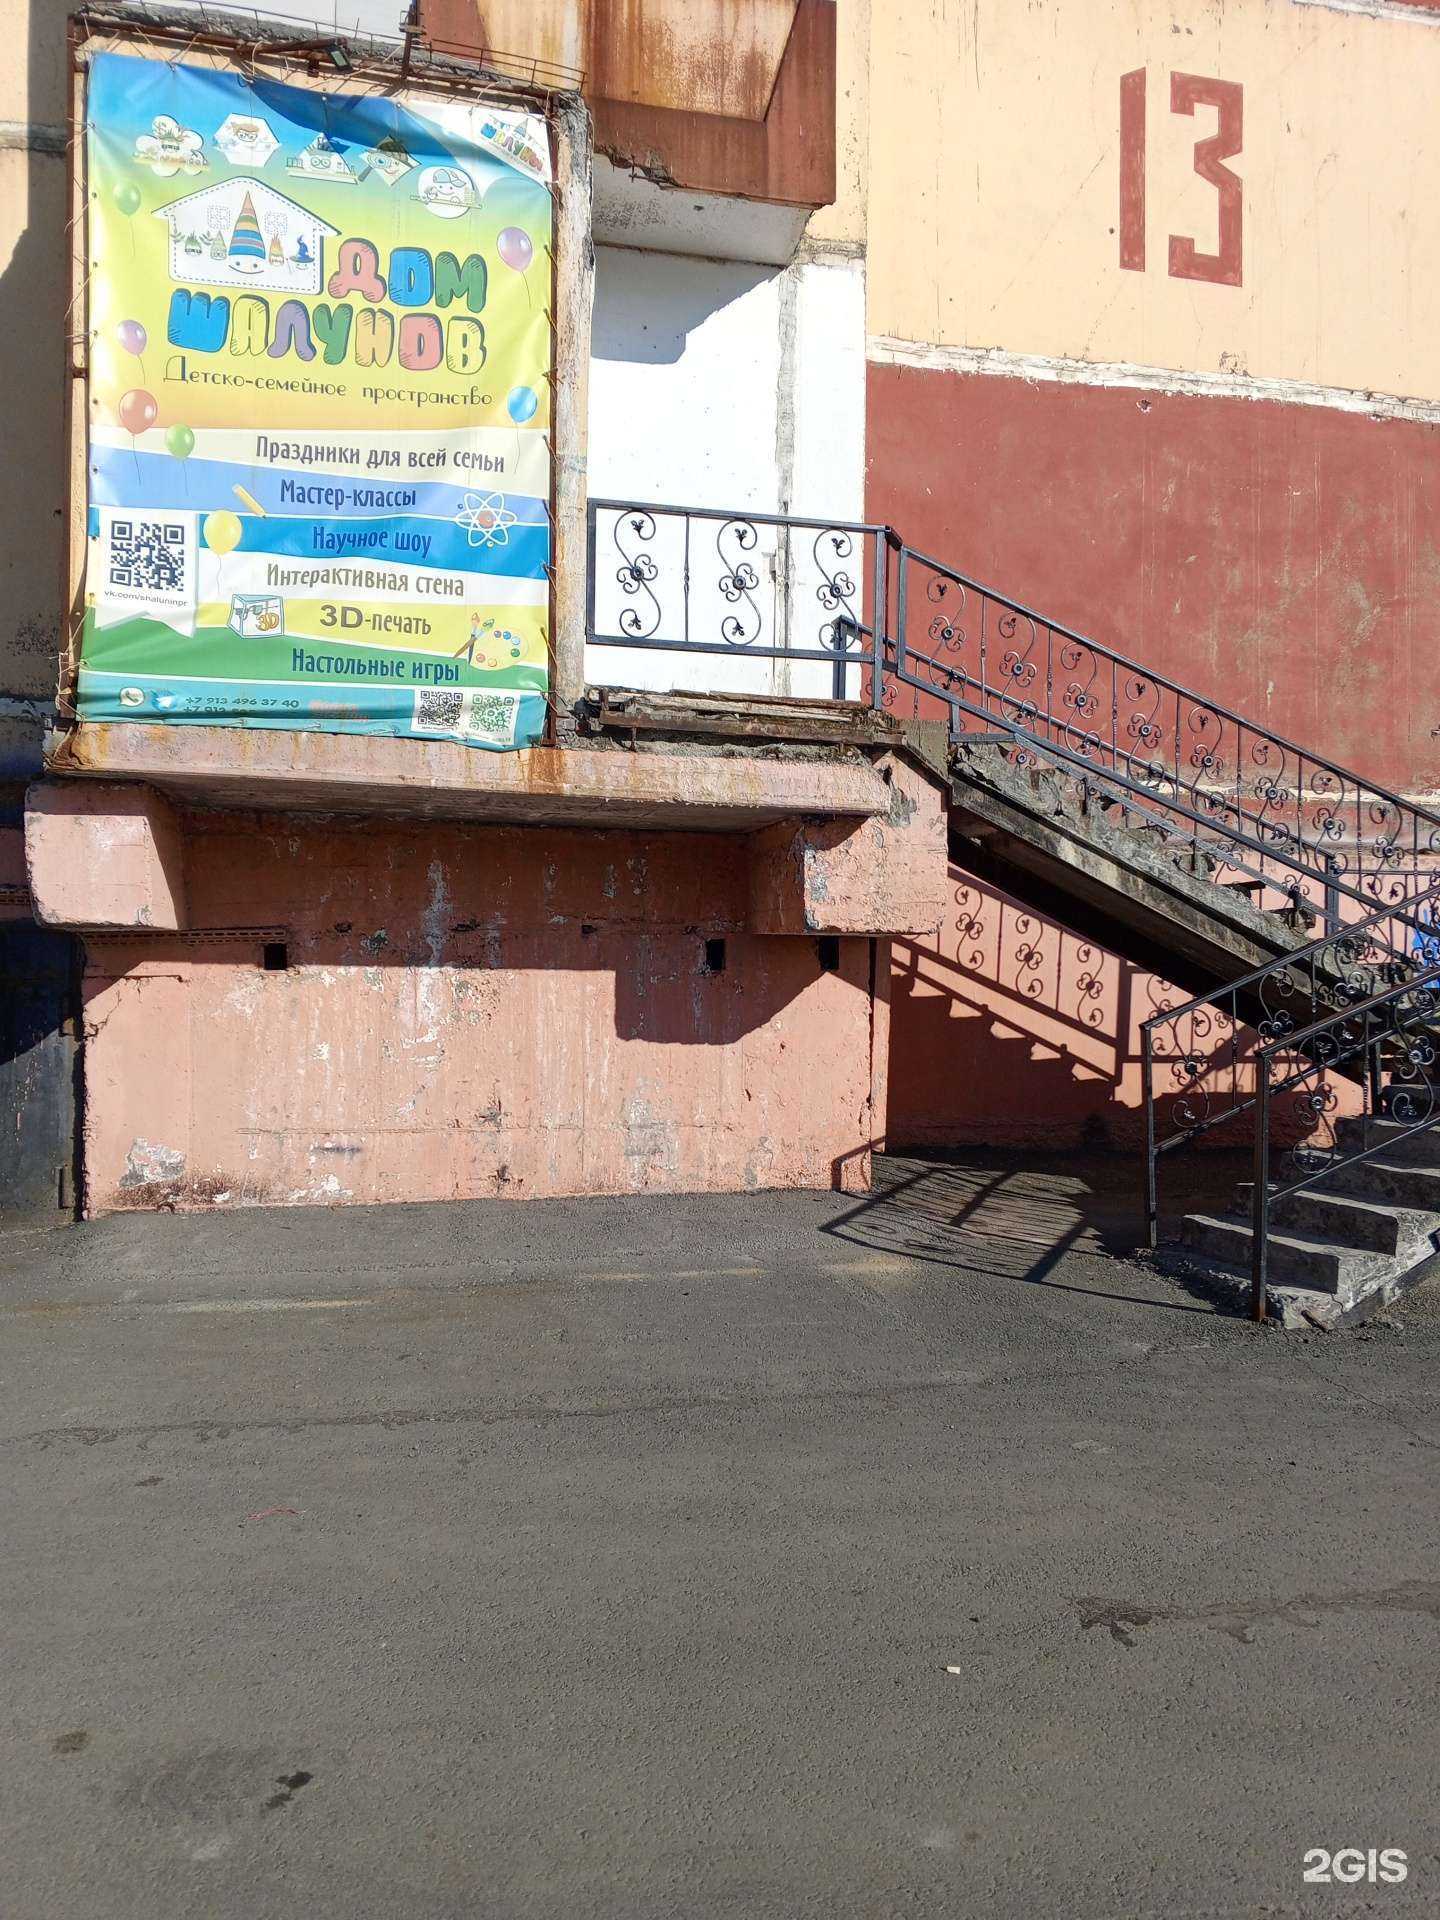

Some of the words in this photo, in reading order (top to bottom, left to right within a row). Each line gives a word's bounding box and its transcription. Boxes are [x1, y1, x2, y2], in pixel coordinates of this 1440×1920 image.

[1119, 66, 1243, 287] 13
[328, 237, 488, 313] ДОМ
[167, 288, 487, 376] ШАЛУНОВ
[163, 355, 347, 397] Детско-семейное
[362, 386, 493, 407] пространство
[256, 435, 360, 463] Праздники
[366, 449, 401, 470] для
[408, 448, 447, 468] всей
[453, 450, 505, 473] семьи
[280, 479, 416, 509] Мастер-классы
[313, 526, 388, 554] Научное
[394, 531, 432, 560] шоу
[267, 563, 408, 592] Интерактивная
[416, 576, 464, 597] стена
[255, 612, 280, 632] 3D
[320, 605, 432, 635] 3D-печать
[292, 647, 405, 677] Настольные
[412, 661, 459, 684] игры
[281, 700, 300, 709] 40
